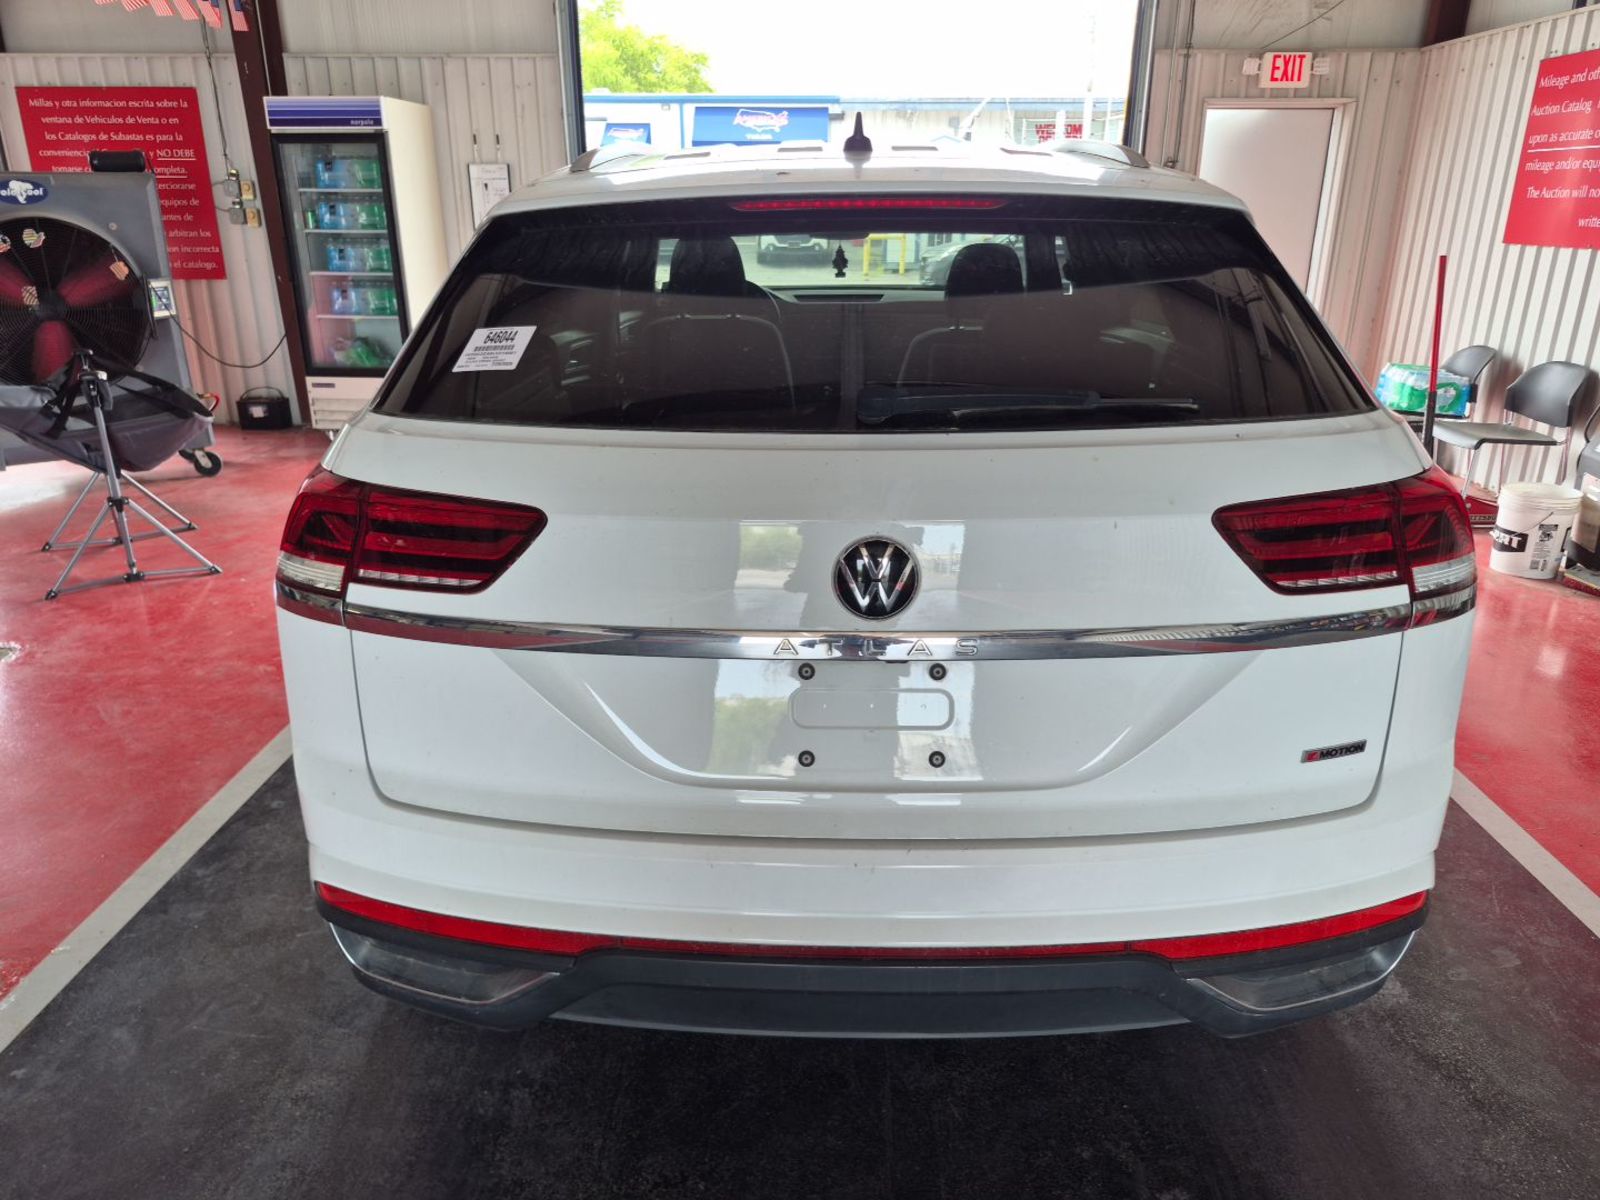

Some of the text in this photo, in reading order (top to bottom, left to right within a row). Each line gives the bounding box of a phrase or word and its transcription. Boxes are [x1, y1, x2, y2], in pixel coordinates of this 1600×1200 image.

[1270, 54, 1307, 82] EXIT
[1539, 74, 1570, 89] Mileage
[1571, 68, 1588, 83] and
[28, 98, 188, 109] Millas y otra informacion escrita sobre la
[1531, 103, 1560, 116] Auction
[1561, 98, 1592, 114] Catalog
[41, 114, 72, 124] ventana
[74, 114, 85, 123] de
[85, 115, 124, 124] Vehiculos
[125, 115, 136, 124] de
[136, 115, 160, 124] Venta
[44, 131, 183, 143] los Catalogos de Subastas es para la
[1528, 133, 1549, 147] upon
[1549, 132, 1558, 143] as
[1559, 129, 1594, 142] accurate
[157, 149, 171, 158] NO
[173, 149, 196, 158] DEBE
[1525, 158, 1555, 174] mileage
[1555, 155, 1582, 170] and/or
[1527, 186, 1540, 199] The
[1540, 187, 1571, 199] Auction
[1571, 184, 1588, 198] will
[189, 196, 200, 206] de
[183, 212, 194, 221] de
[168, 228, 212, 238] arbitran los
[180, 245, 220, 253] incorrecta
[173, 260, 181, 268] el
[482, 330, 519, 345] 646044
[773, 637, 979, 657] ATLAS
